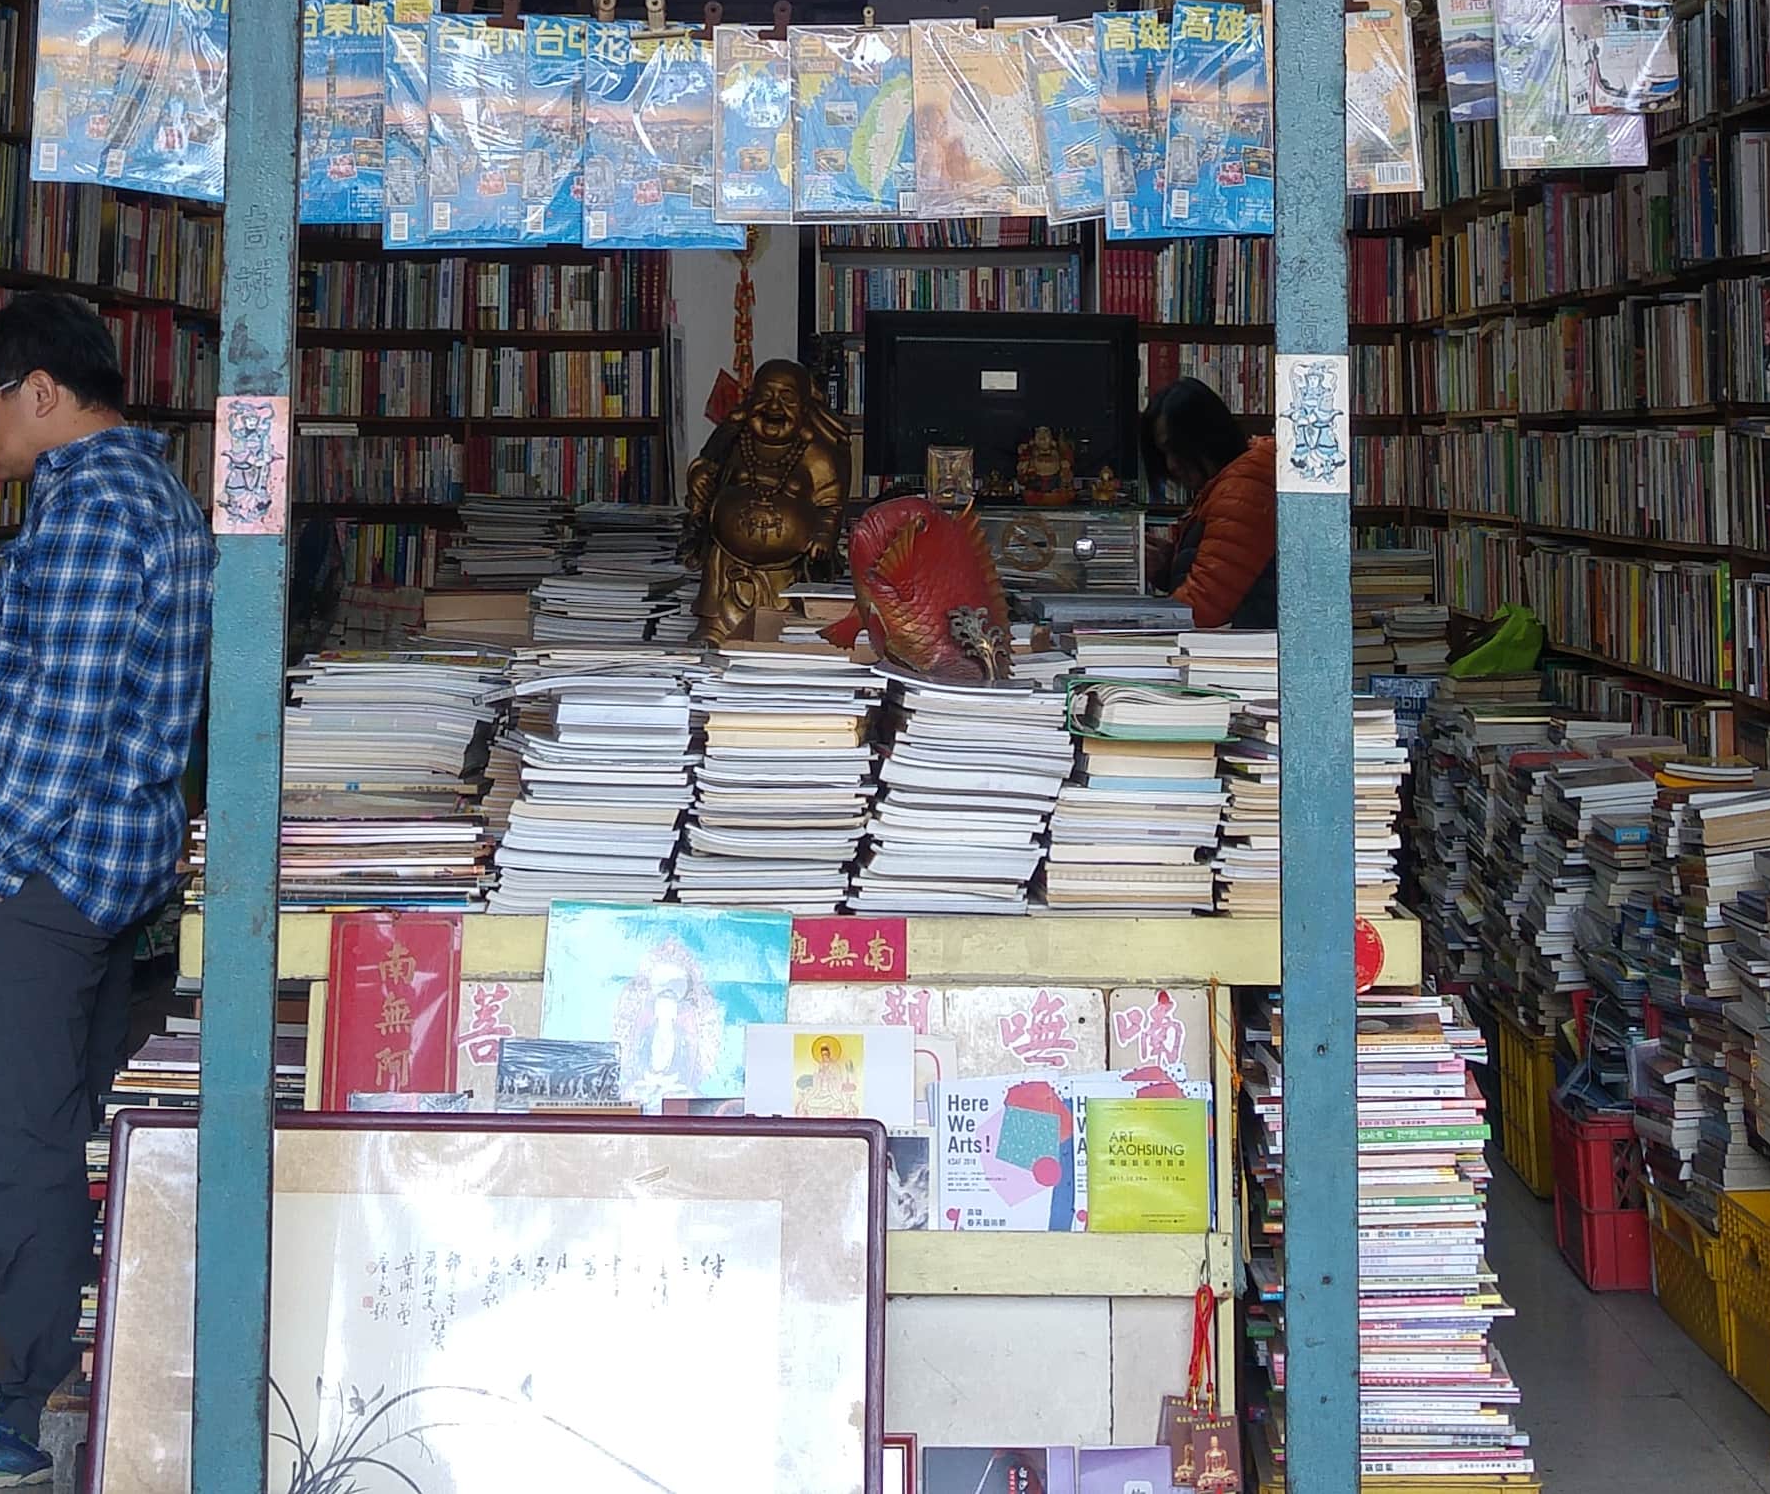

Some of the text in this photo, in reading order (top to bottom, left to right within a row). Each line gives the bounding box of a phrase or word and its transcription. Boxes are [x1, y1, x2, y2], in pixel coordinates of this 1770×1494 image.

[947, 1094, 989, 1112] Here
[947, 1115, 976, 1132] We
[947, 1136, 991, 1154] Arts!
[1109, 1131, 1134, 1143] ART
[1108, 1144, 1185, 1156] KAOHSIUNG
